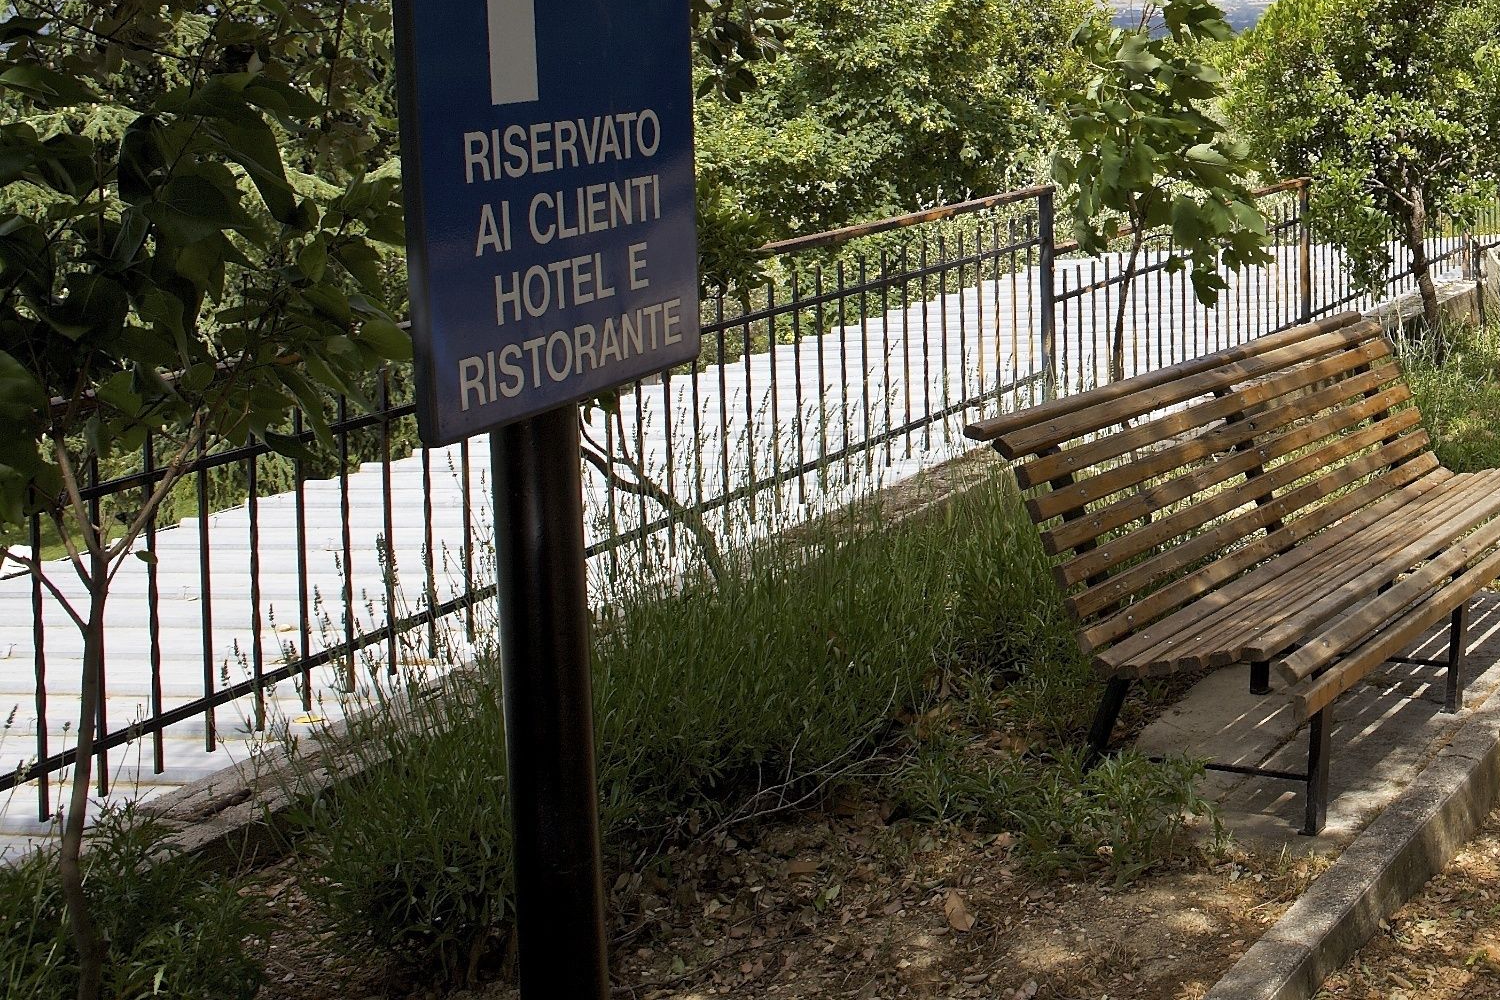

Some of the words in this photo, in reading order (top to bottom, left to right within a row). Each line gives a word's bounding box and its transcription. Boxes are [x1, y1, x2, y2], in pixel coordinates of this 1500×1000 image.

[464, 108, 661, 184] RISERVATO
[475, 200, 512, 257] AI
[529, 174, 661, 239] CLIENTI
[494, 254, 615, 326] HOTEL
[628, 241, 649, 291] E
[458, 297, 683, 412] RISTORANTE
